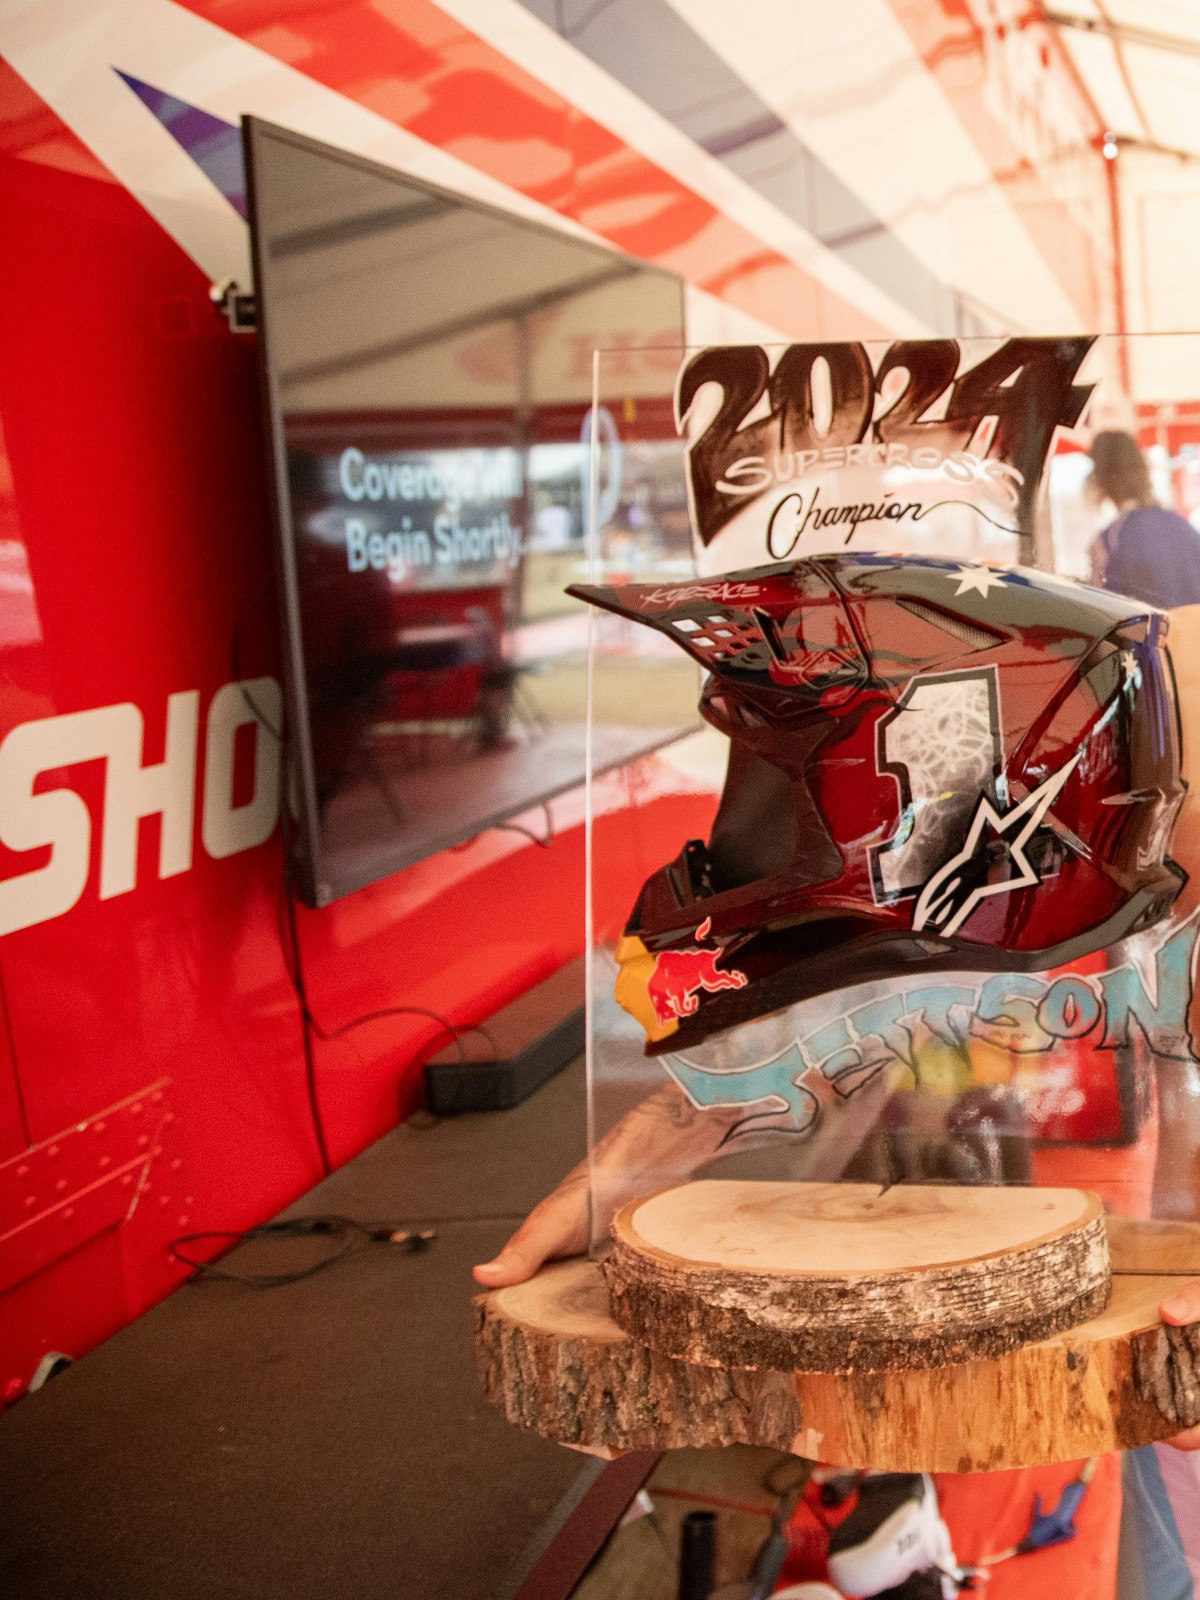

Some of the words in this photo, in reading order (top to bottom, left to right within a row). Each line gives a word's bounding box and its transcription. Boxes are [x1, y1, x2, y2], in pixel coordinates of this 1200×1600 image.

[675, 336, 1101, 556] 2024
[715, 443, 1025, 506] SUPERCROSS
[346, 516, 432, 583] Begin
[766, 488, 1032, 561] Champion
[867, 664, 1010, 908] 1
